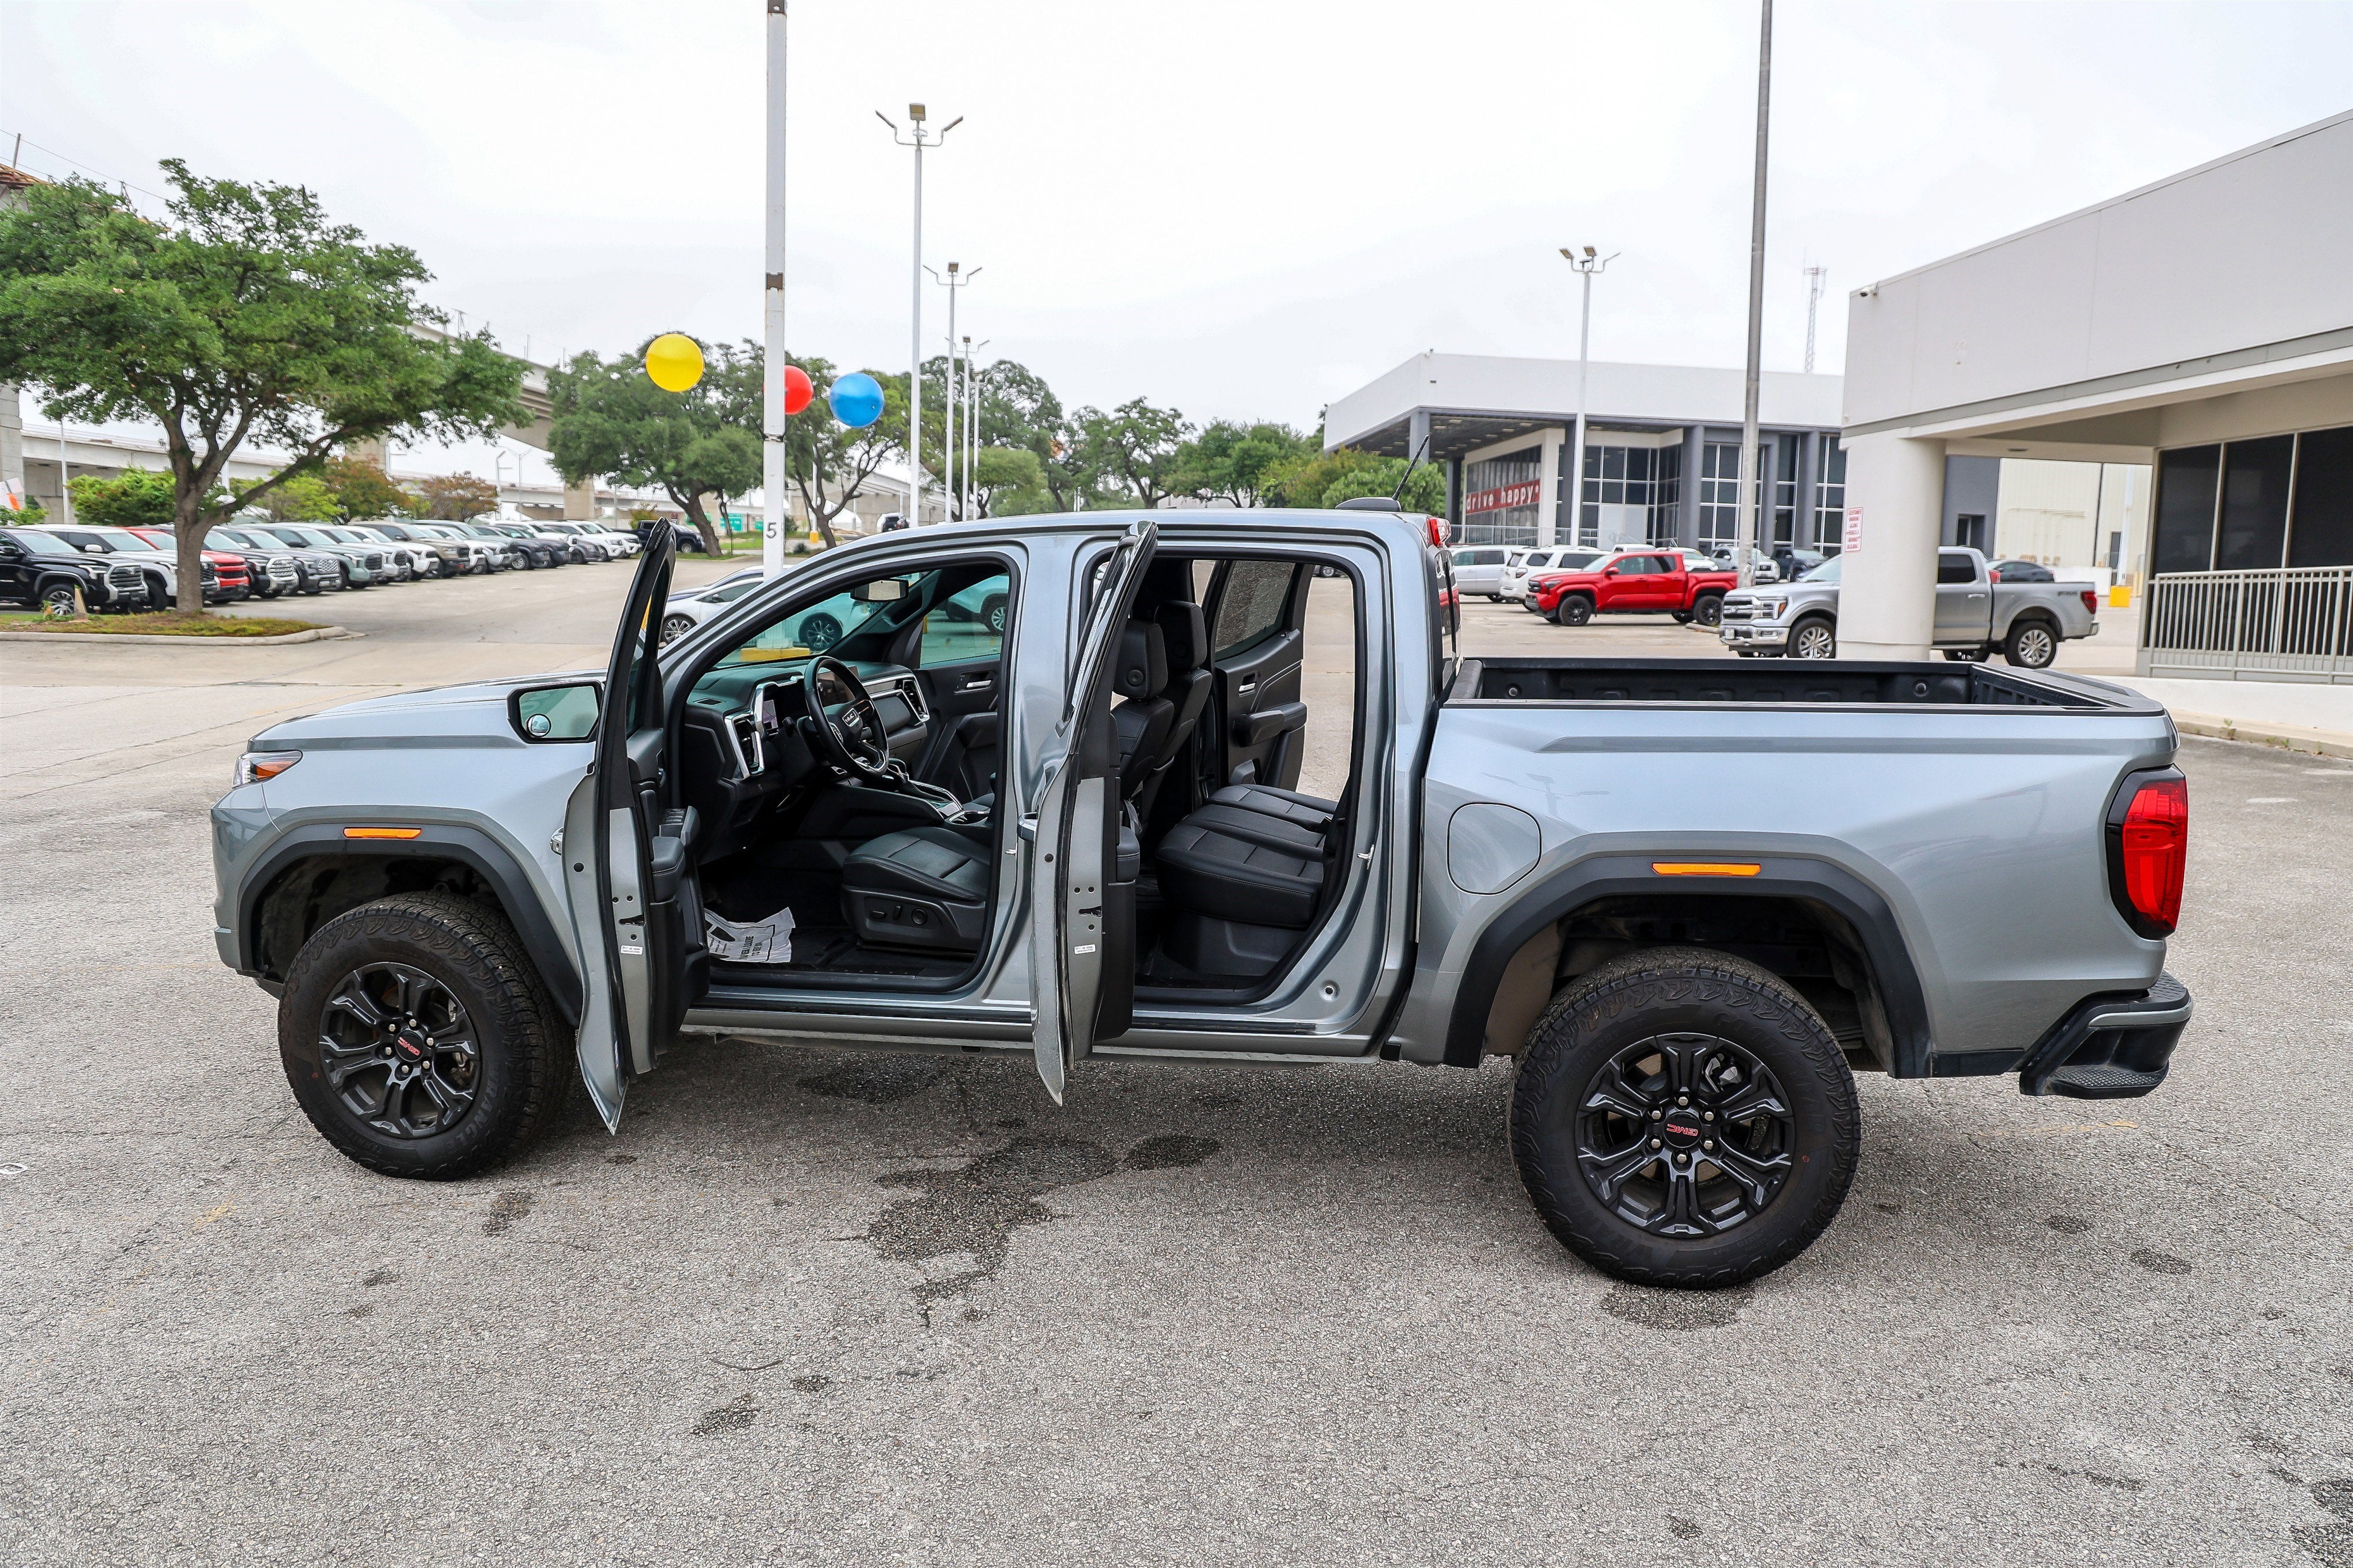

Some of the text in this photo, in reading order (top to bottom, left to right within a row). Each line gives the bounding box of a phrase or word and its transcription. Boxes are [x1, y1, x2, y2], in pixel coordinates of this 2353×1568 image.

[1467, 492, 1494, 510] drive
[766, 522, 777, 539] 5
[398, 1036, 421, 1056] GMC
[1712, 1010, 1826, 1133] GOODYEAR
[1666, 1123, 1699, 1137] GMC
